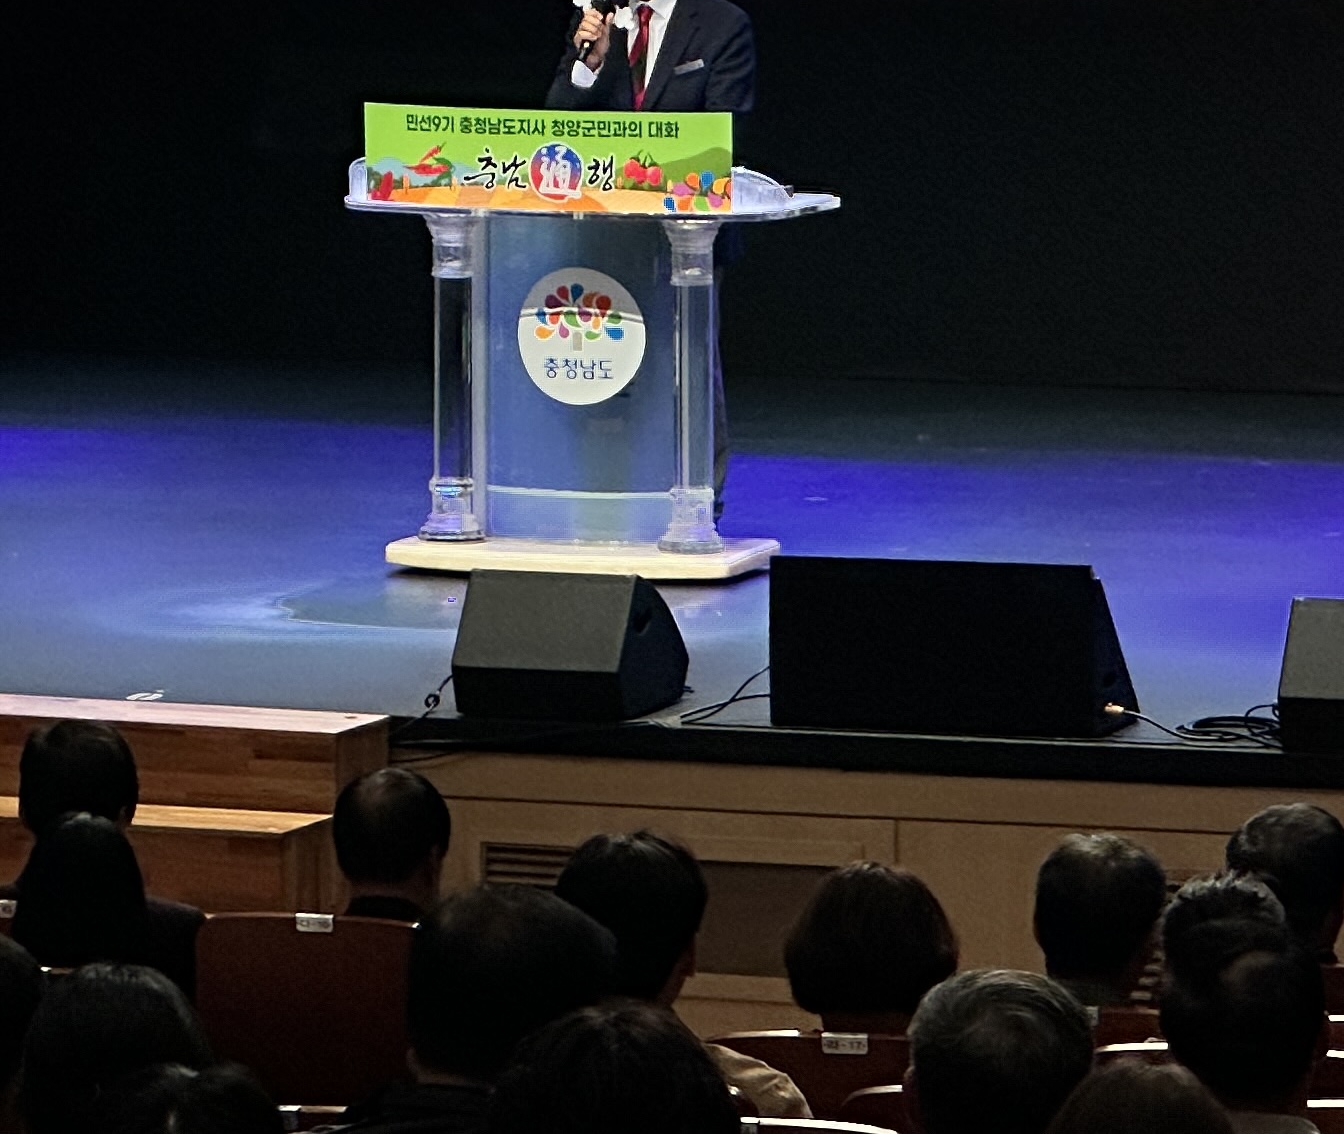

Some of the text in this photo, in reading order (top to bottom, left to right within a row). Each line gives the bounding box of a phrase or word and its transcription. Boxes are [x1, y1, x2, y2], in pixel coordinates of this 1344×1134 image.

[406, 114, 679, 139] 민선9기 충청남도지사 청양군민과의 대화
[464, 148, 526, 188] 충남
[588, 157, 614, 191] 행
[544, 358, 613, 379] 충청남도
